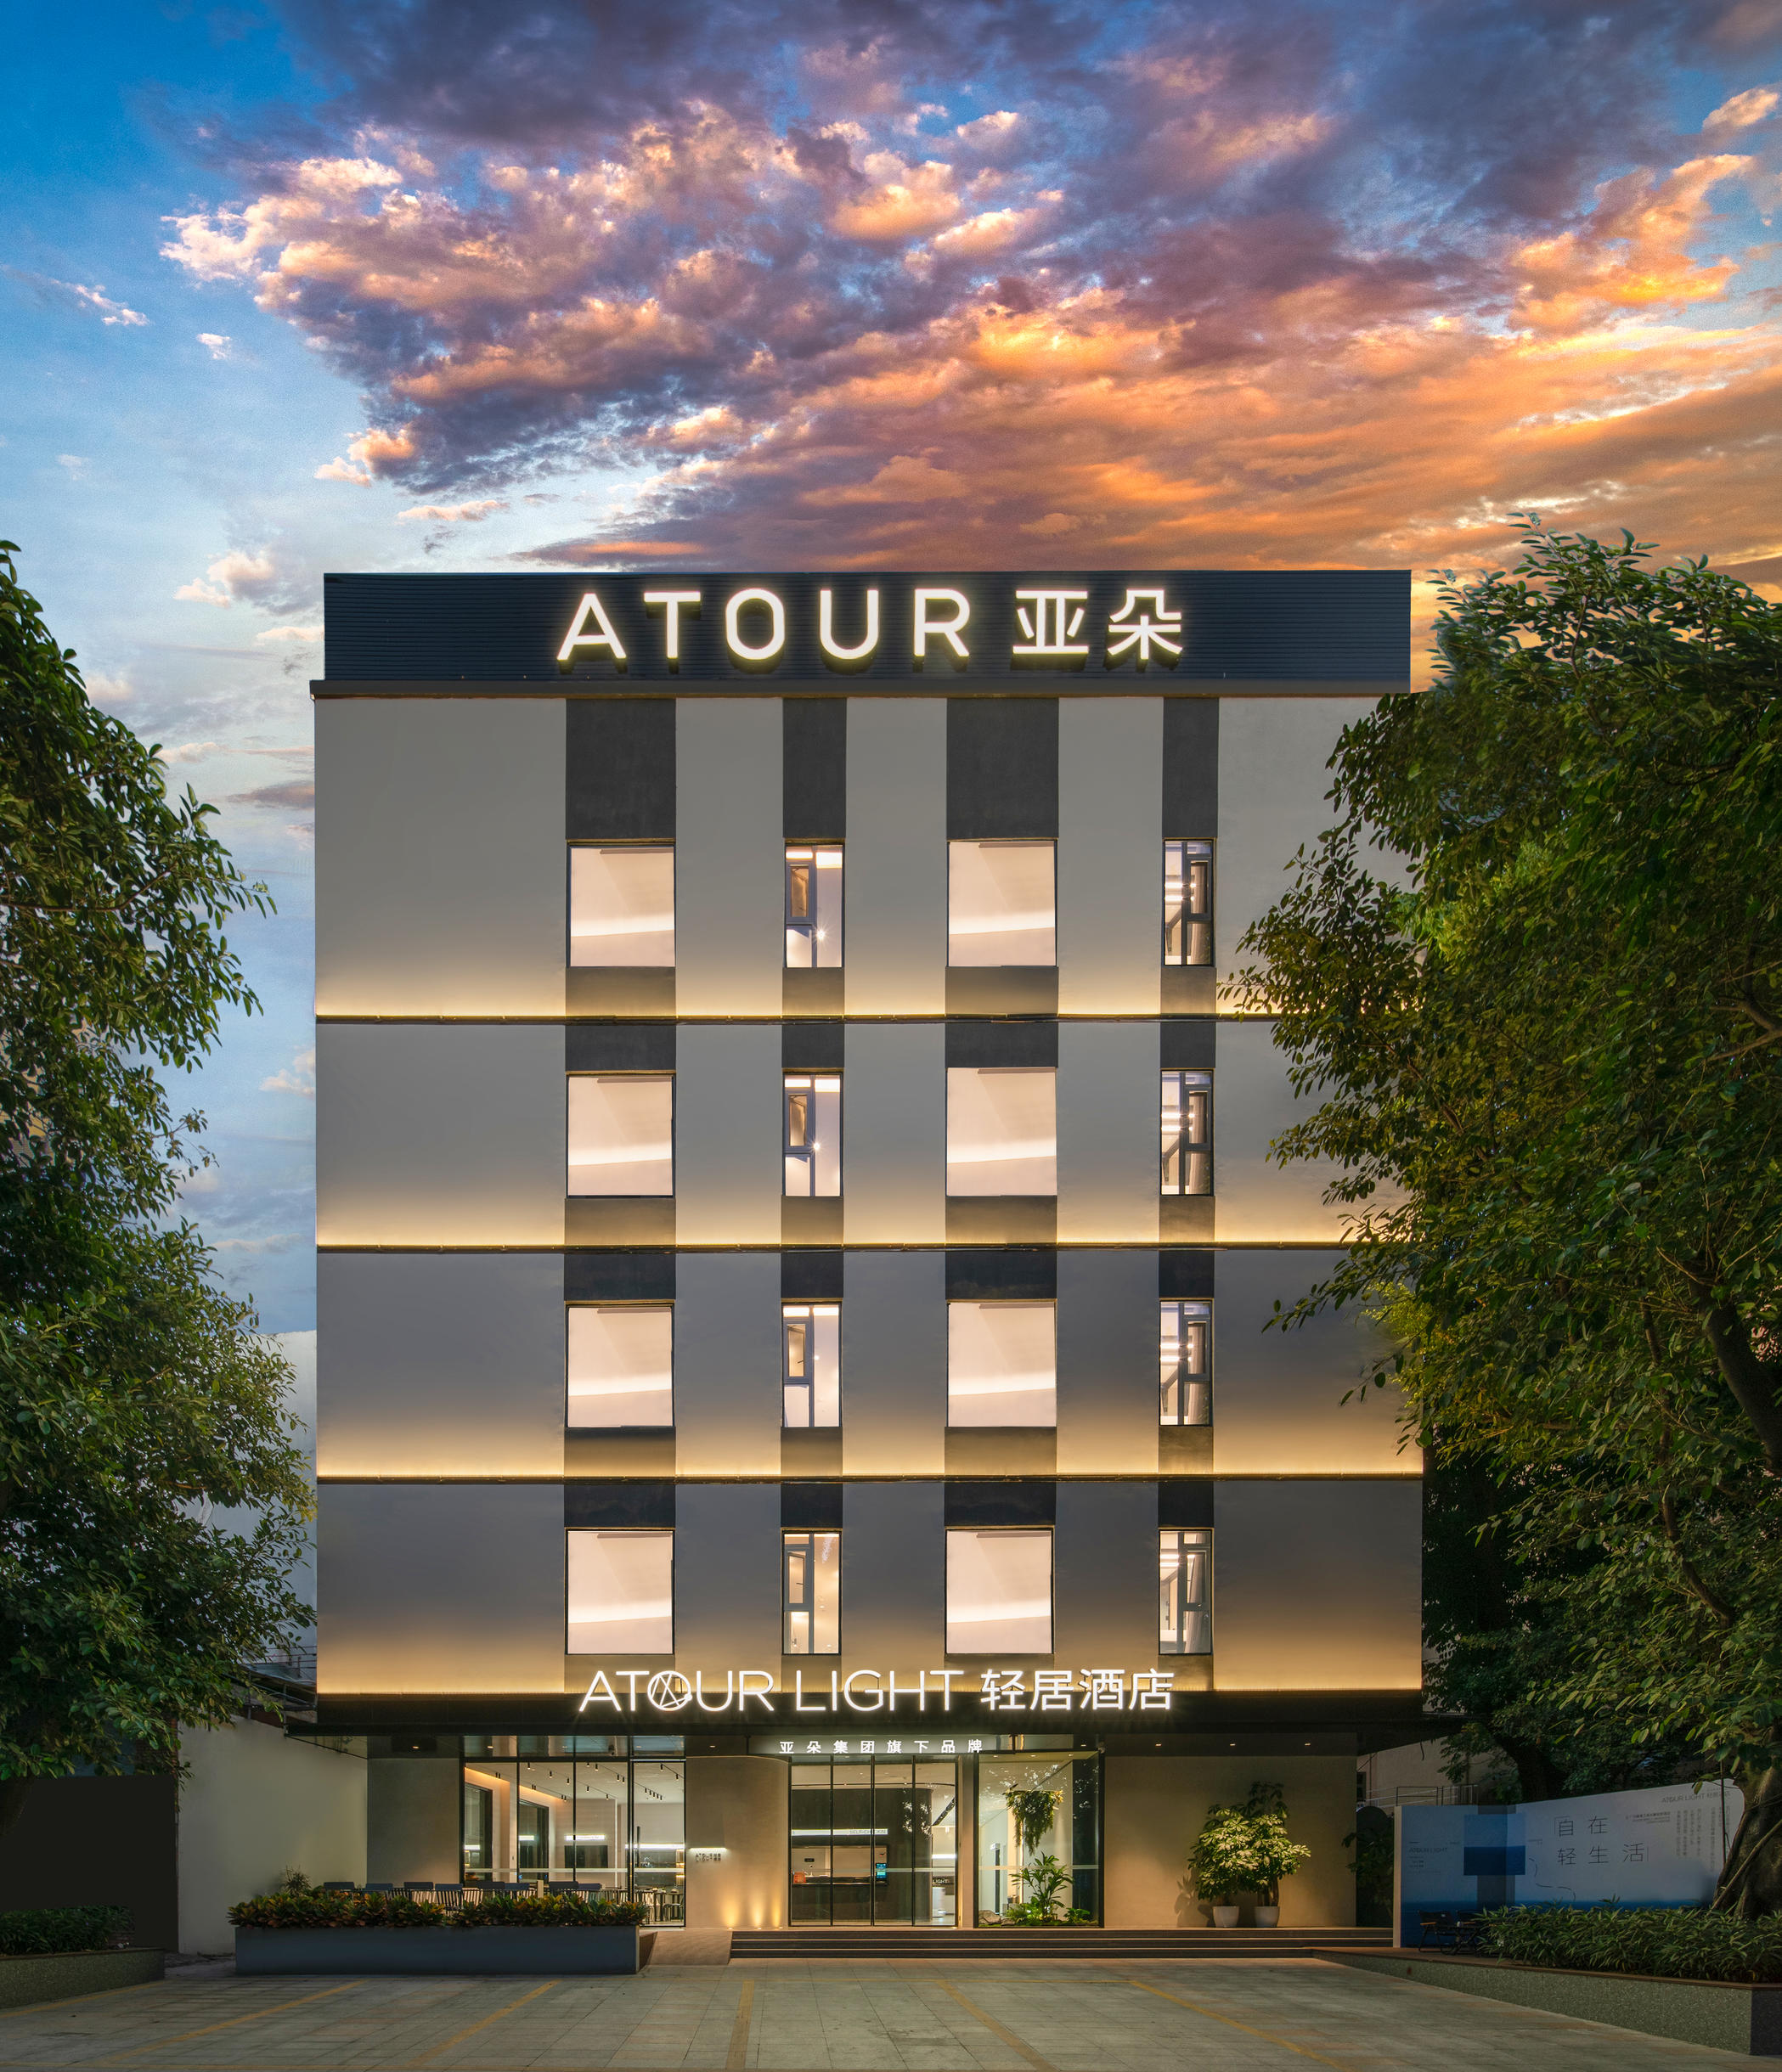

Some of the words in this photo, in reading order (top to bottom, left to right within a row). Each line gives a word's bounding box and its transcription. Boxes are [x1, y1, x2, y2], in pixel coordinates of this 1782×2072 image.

[555, 586, 972, 662] ATOUR
[1012, 588, 1184, 661] 亚朵
[578, 1669, 775, 1714] ATOUR
[796, 1669, 965, 1713] LIGHT
[979, 1667, 1176, 1712] 轻居酒店
[779, 1739, 984, 1755] 亚朵集团旗下品牌
[1558, 1815, 1609, 1837] 自在
[1558, 1842, 1644, 1866] 轻生活
